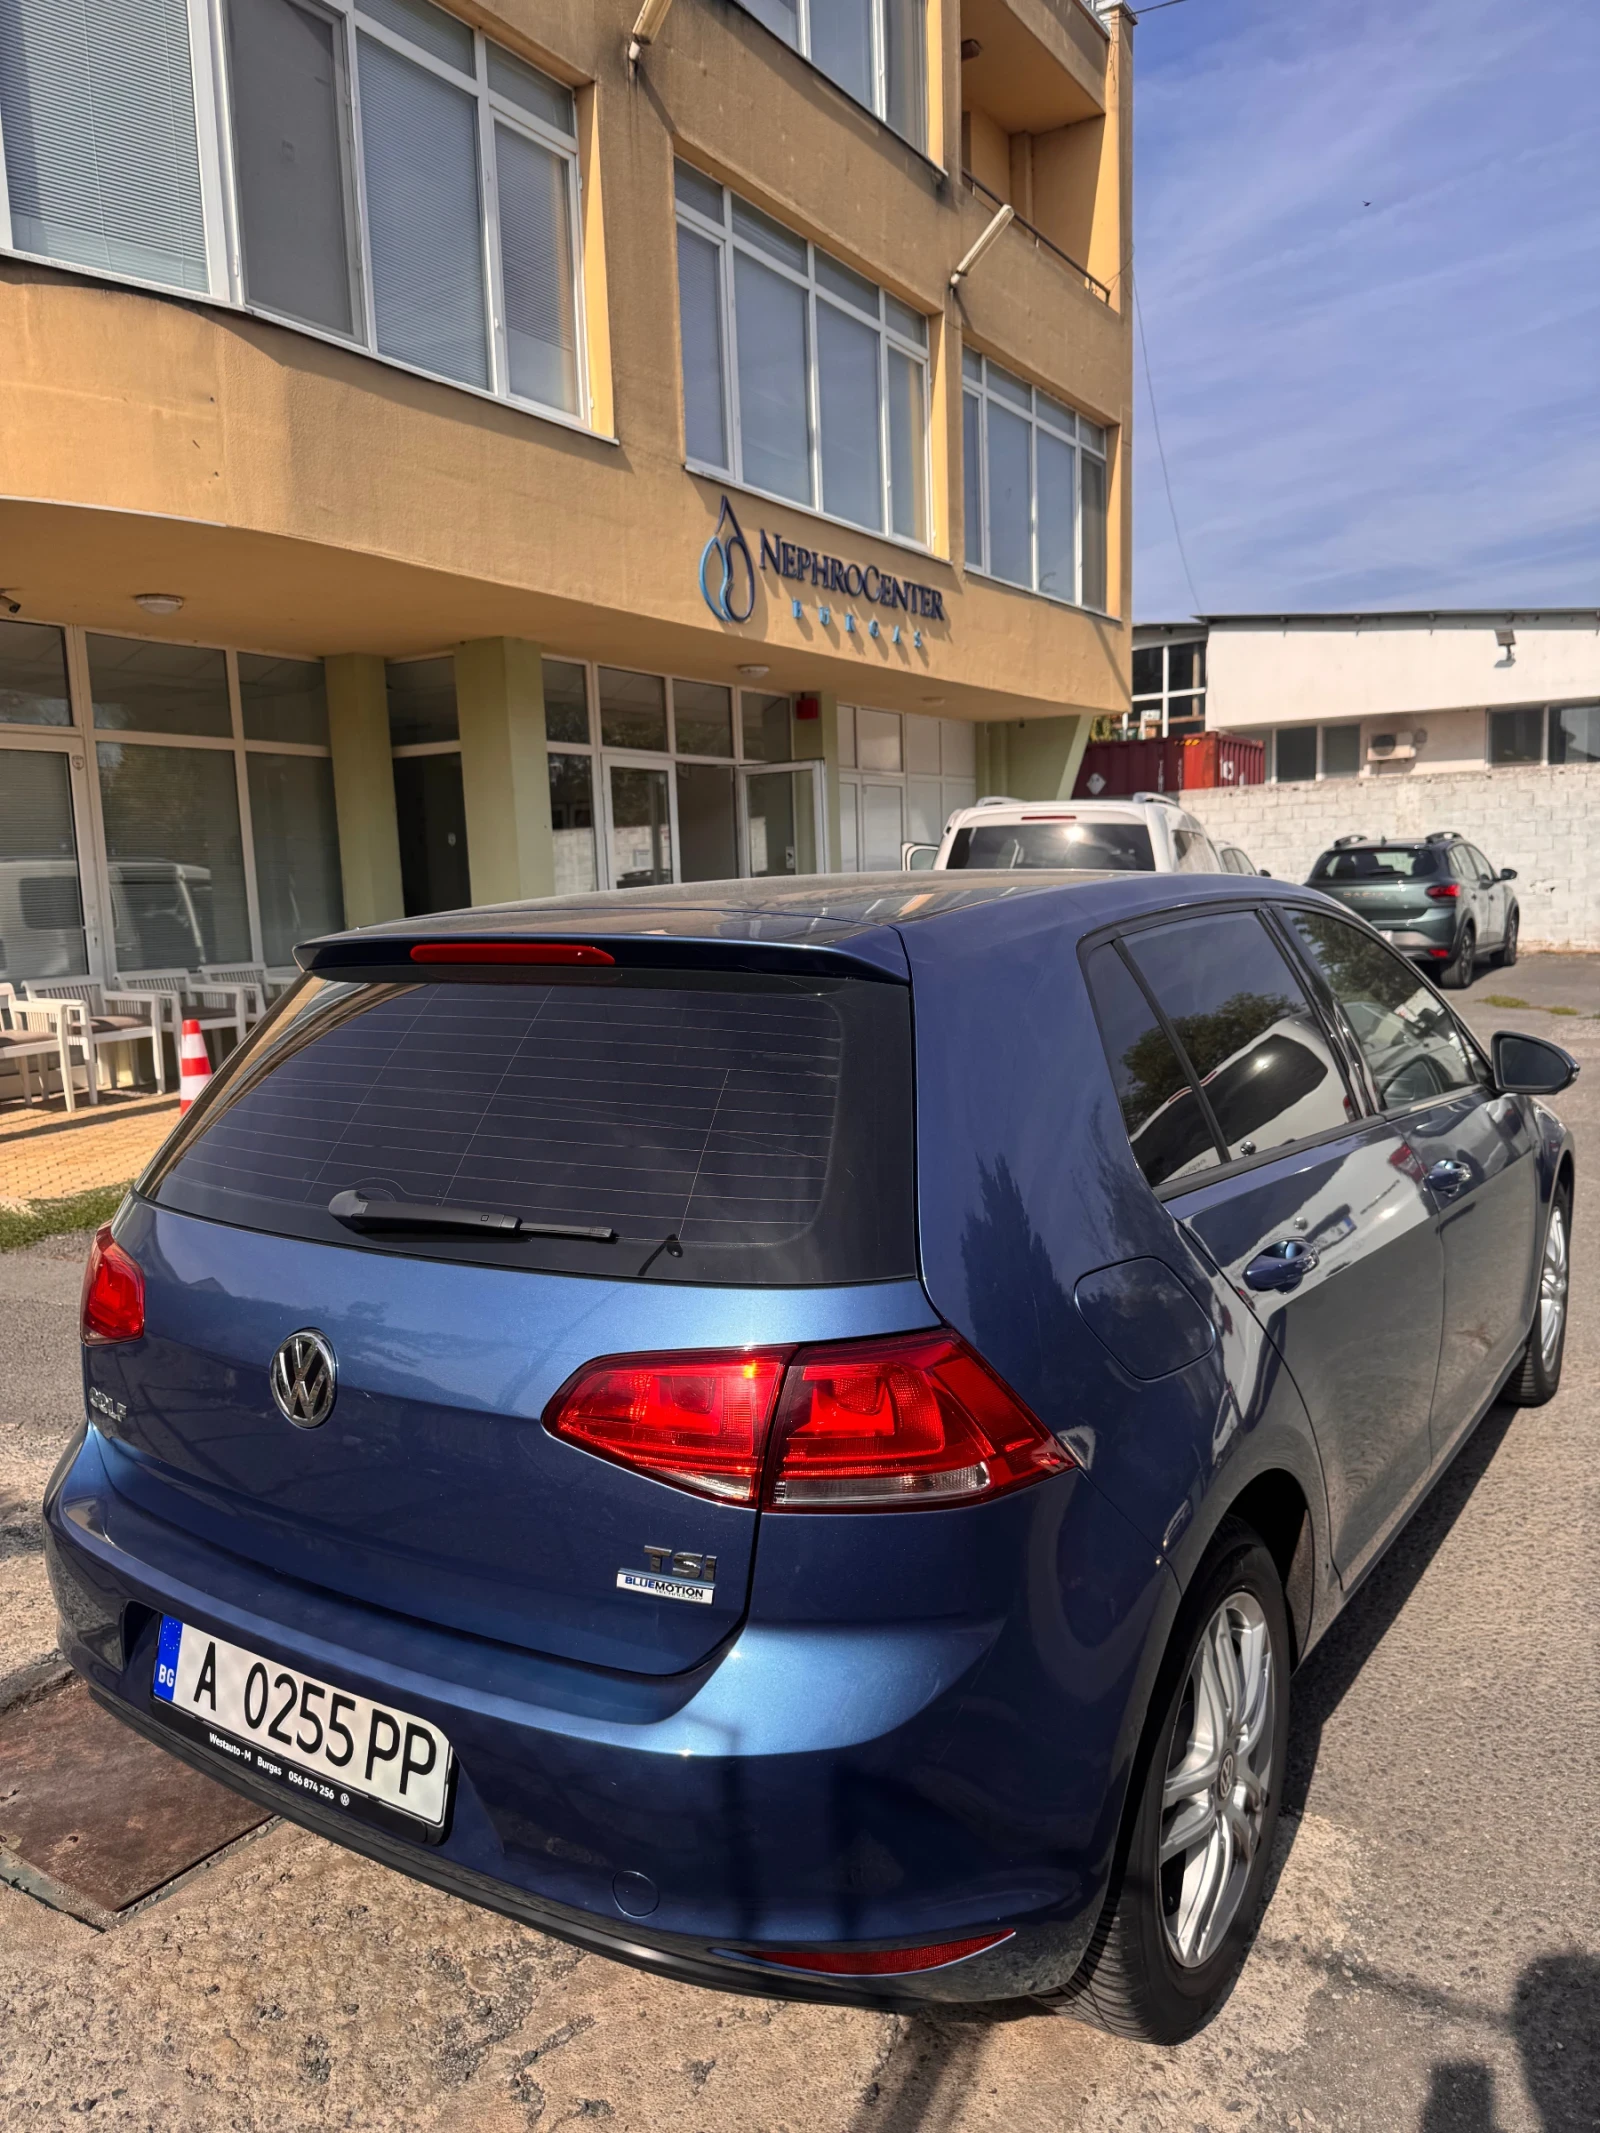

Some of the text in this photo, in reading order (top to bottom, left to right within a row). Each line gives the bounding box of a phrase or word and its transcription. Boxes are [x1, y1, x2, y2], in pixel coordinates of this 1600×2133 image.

[792, 597, 922, 648] BURGAS
[89, 1386, 127, 1422] GOLF
[643, 1545, 717, 1581] TSI
[625, 1576, 704, 1598] BLUEMOTION
[158, 1663, 175, 1687] BG
[193, 1641, 437, 1795] A 0255 PP
[257, 1756, 282, 1776] Burgas
[288, 1770, 302, 1786] 056
[304, 1778, 318, 1792] 874
[319, 1785, 335, 1800] 256
